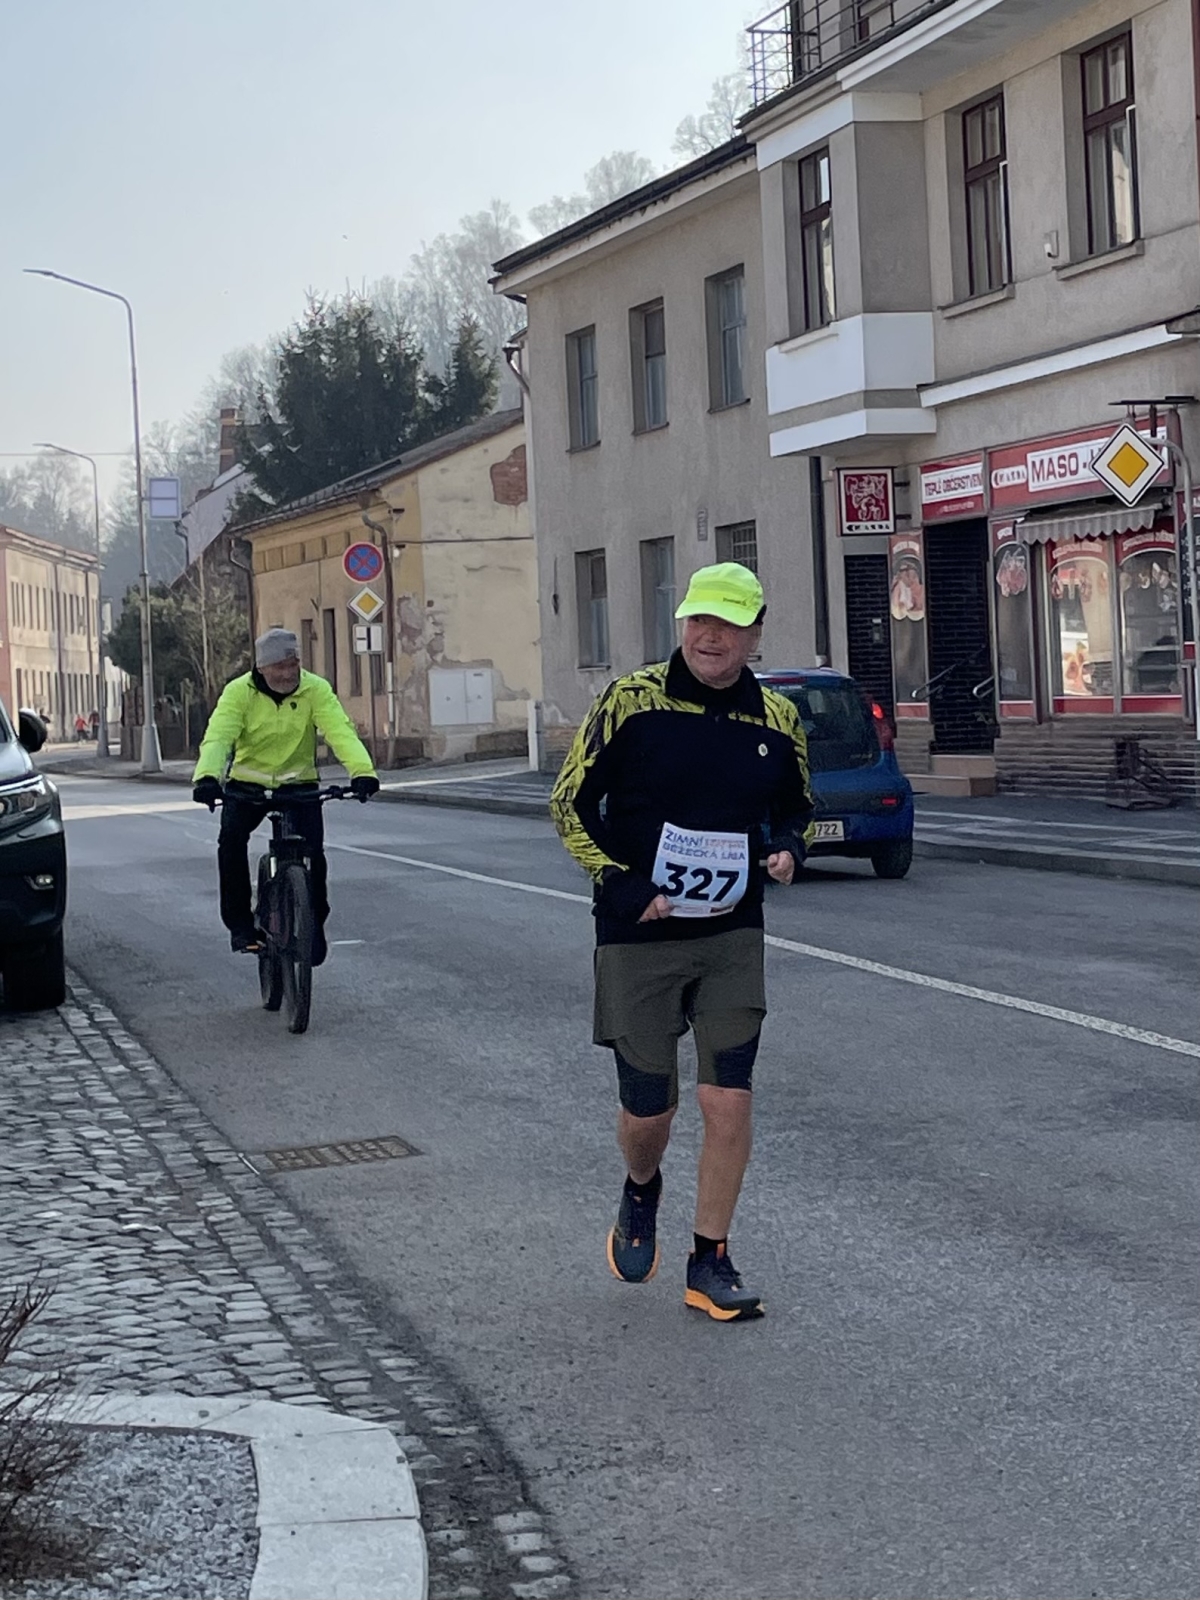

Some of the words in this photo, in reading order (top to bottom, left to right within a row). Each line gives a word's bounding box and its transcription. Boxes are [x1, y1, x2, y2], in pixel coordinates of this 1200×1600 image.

[1031, 452, 1079, 483] MASO
[816, 823, 838, 836] 722
[659, 861, 740, 902] 327
